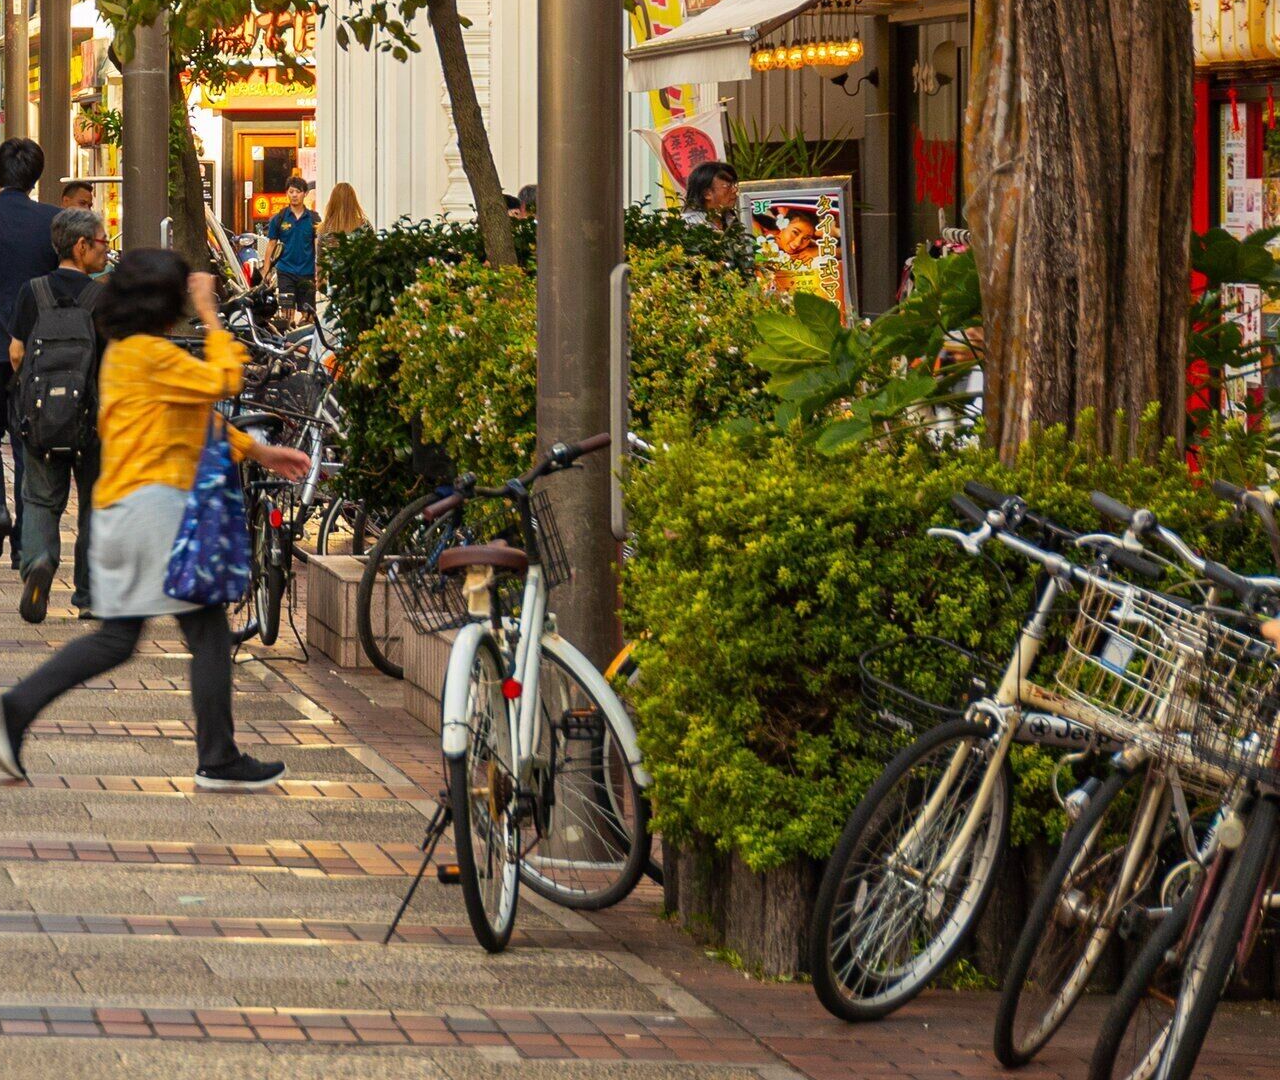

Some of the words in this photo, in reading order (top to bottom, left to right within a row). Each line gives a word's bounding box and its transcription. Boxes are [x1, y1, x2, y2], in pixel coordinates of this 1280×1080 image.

[753, 200, 770, 214] 3F
[816, 194, 841, 306] タイ古式マ
[878, 707, 914, 734] Jeep
[1054, 720, 1113, 746] Jeep
